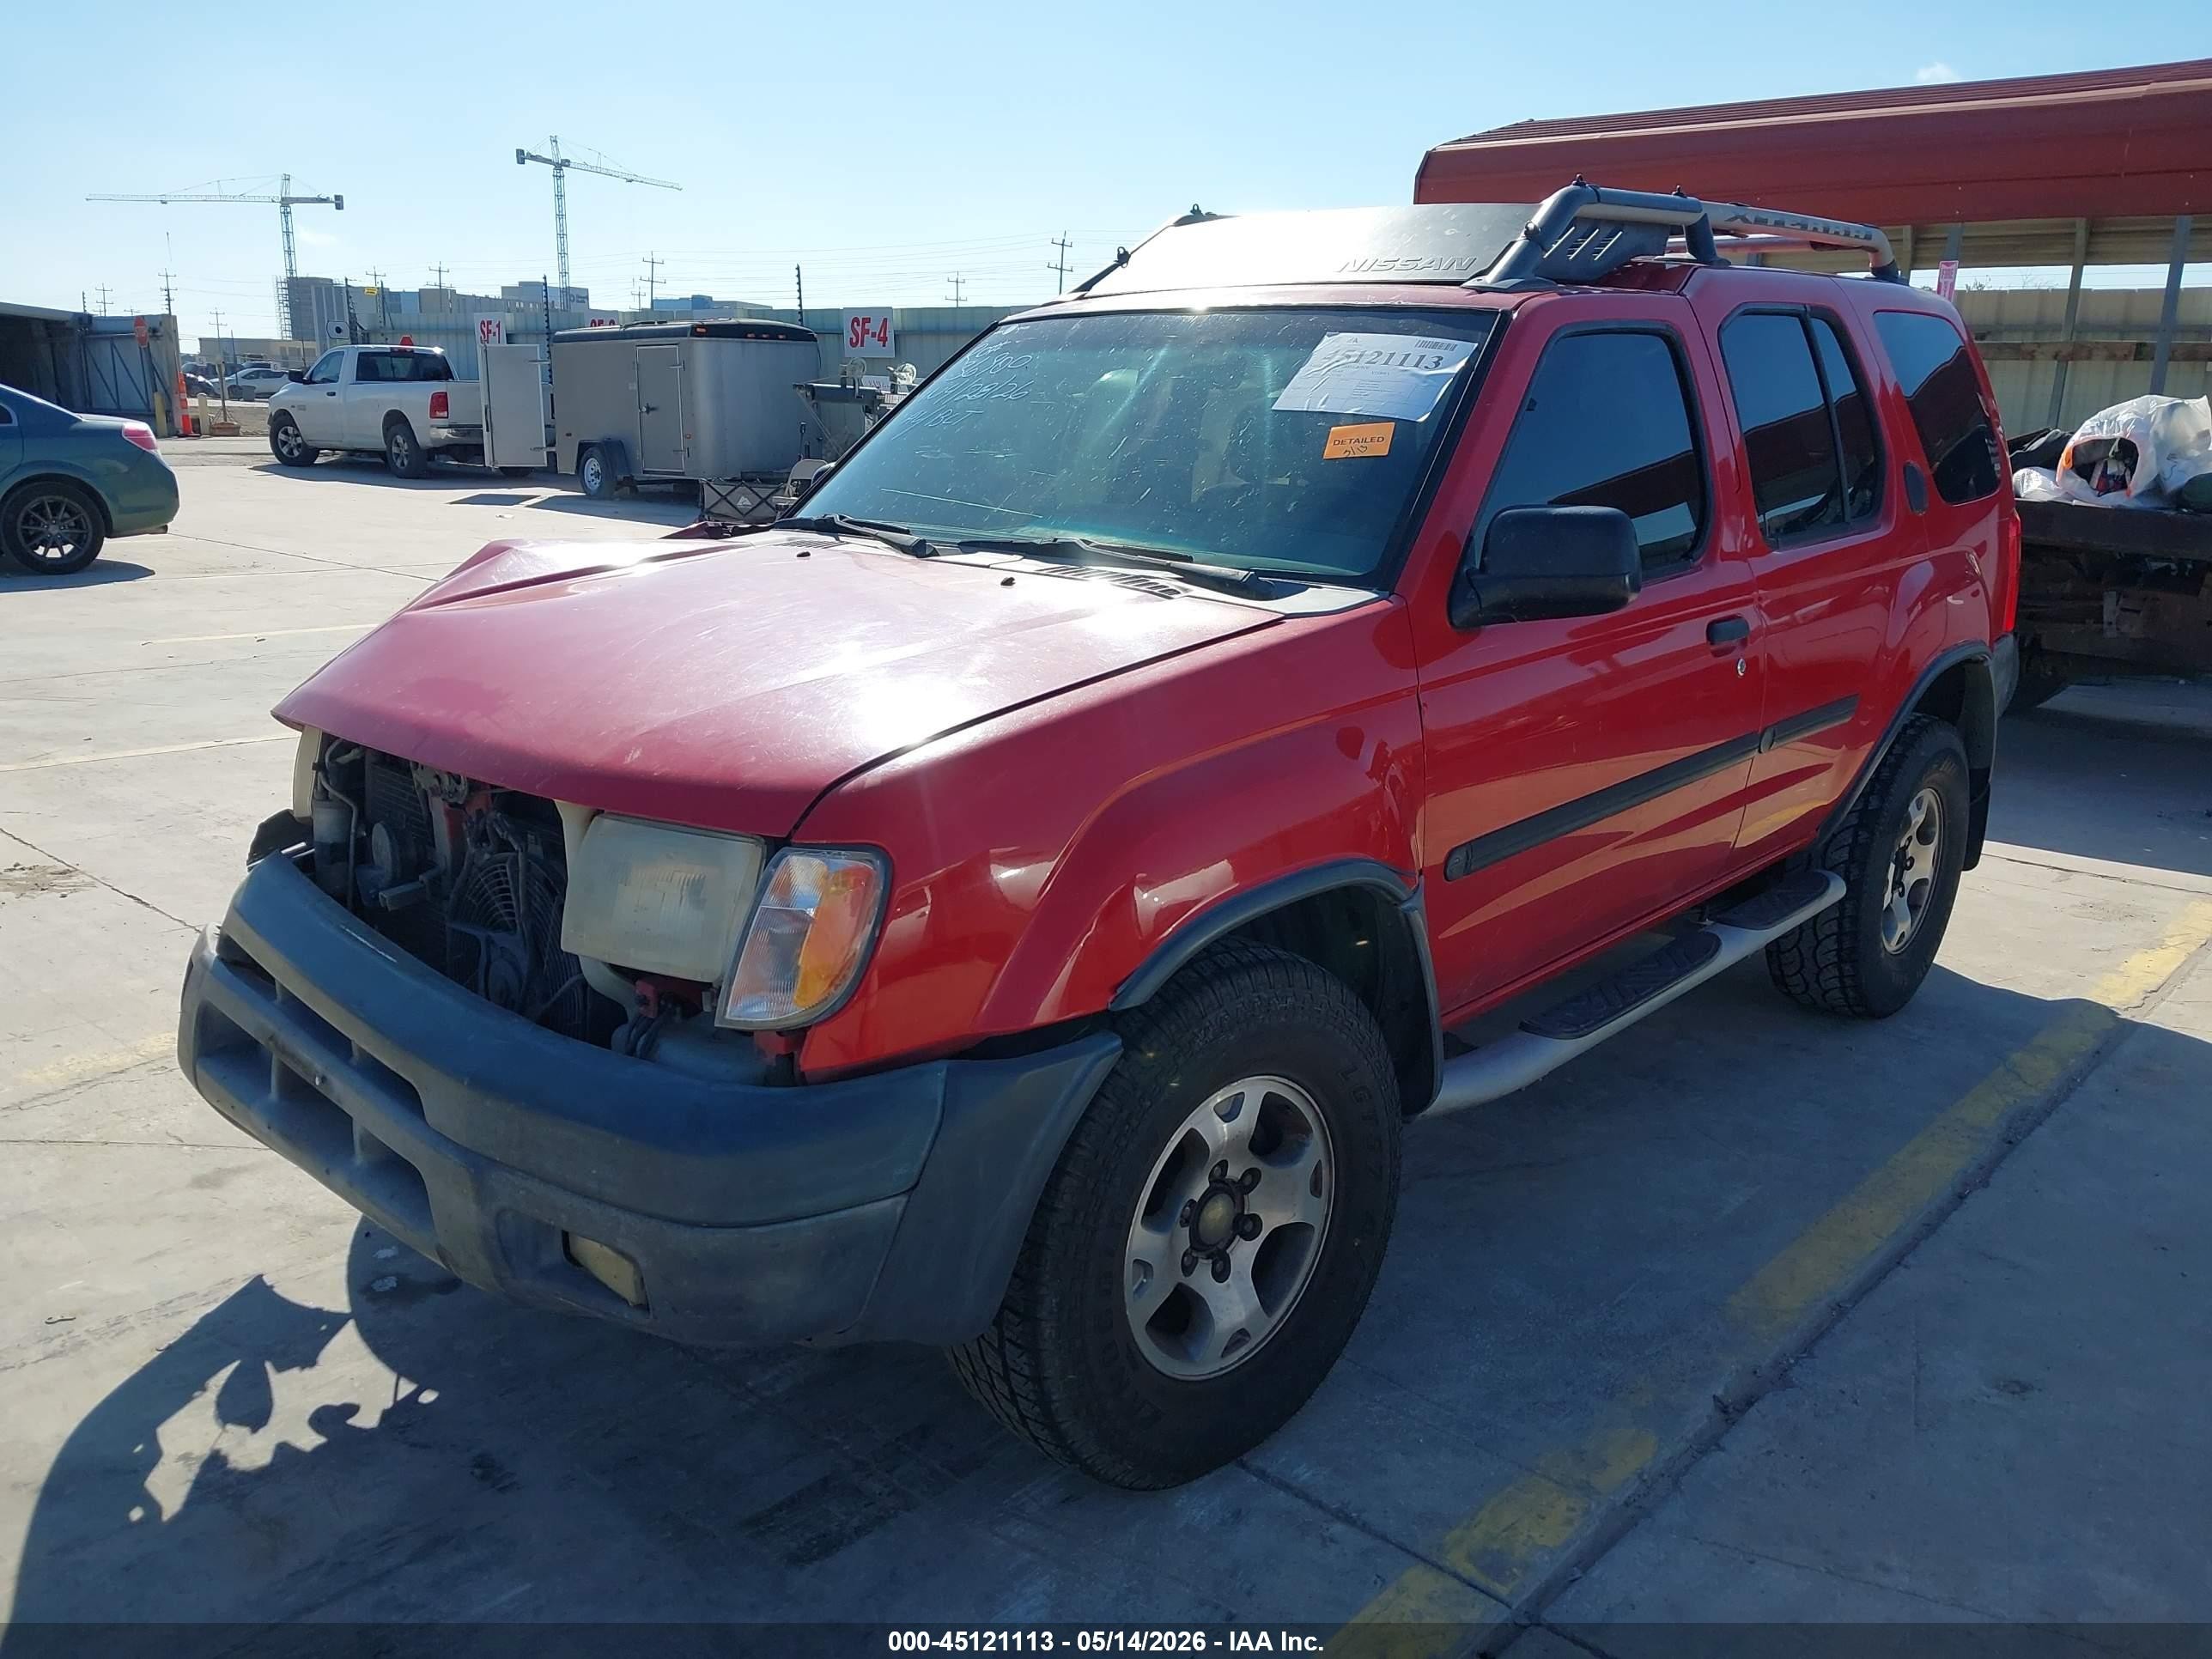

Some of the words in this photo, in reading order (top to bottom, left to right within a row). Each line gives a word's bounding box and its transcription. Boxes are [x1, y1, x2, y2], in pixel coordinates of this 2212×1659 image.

[1334, 257, 1477, 273] NISSAN
[480, 320, 501, 343] SF-1
[849, 316, 888, 348] SF-4
[1333, 436, 1385, 446] DETAILED
